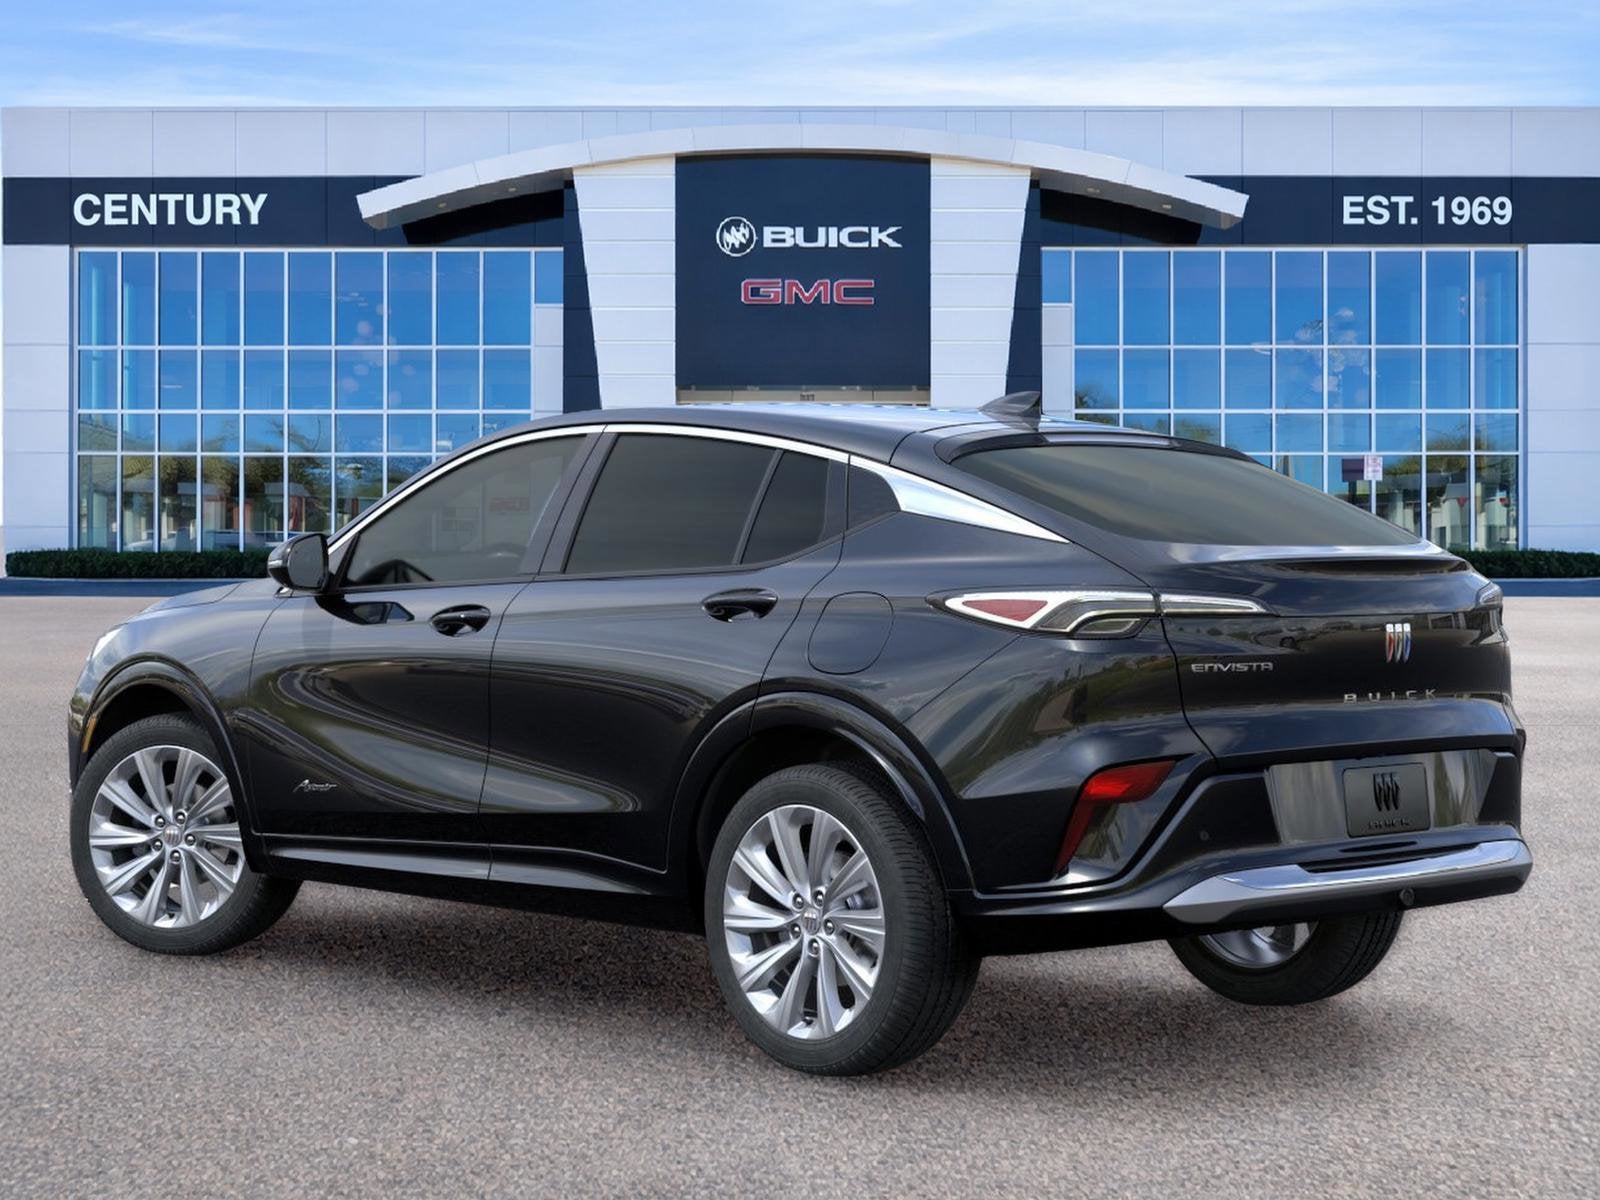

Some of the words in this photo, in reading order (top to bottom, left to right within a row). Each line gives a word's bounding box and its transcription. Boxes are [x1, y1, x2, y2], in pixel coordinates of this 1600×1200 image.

[73, 193, 268, 226] CENTURY
[1342, 195, 1418, 226] EST.
[1431, 195, 1513, 226] 1969
[762, 226, 903, 249] BUICK
[741, 278, 875, 306] GMC
[1343, 688, 1437, 704] BUICK
